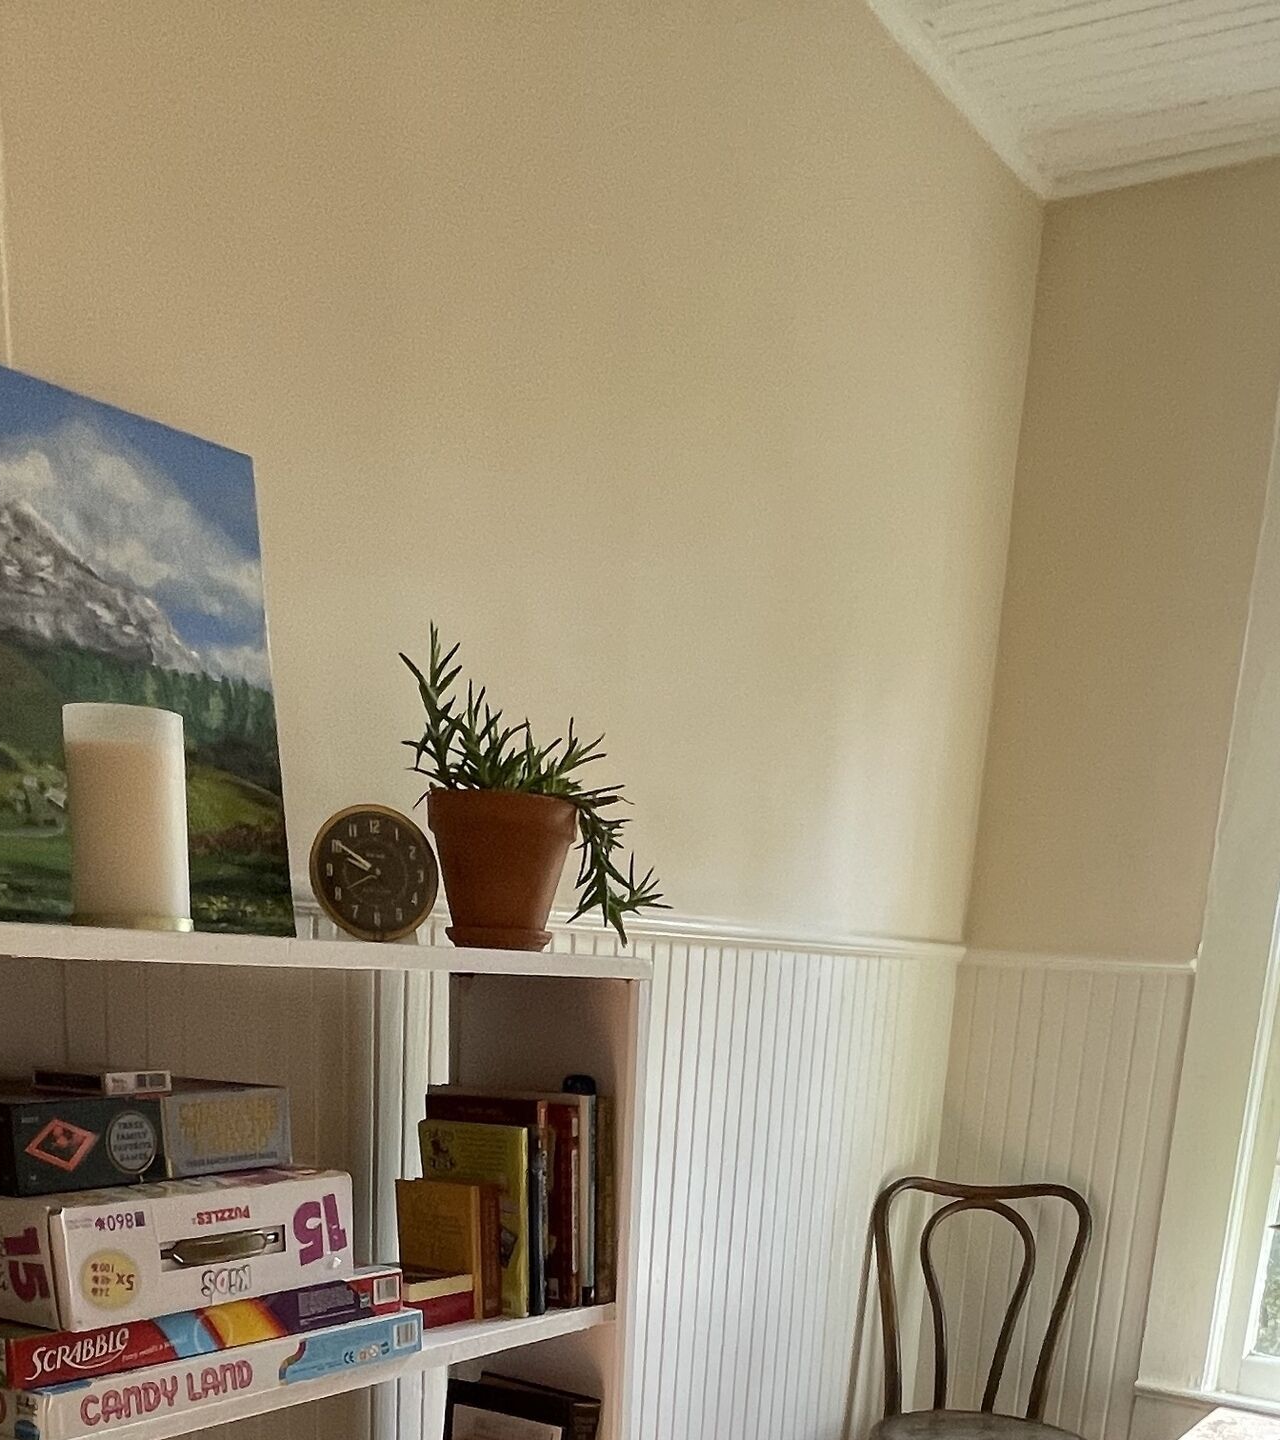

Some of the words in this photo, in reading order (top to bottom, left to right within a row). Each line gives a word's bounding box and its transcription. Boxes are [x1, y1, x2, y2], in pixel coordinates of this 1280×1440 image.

[348, 823, 358, 837] 11
[370, 820, 380, 834] 12
[409, 845, 416, 860] 2
[410, 892, 418, 906] 4
[351, 905, 359, 919] 7
[107, 1212, 135, 1232] 860
[196, 1205, 252, 1227] PUZZLES
[292, 1193, 348, 1267] 15
[3, 1226, 51, 1304] 15
[25, 1327, 130, 1382] SCRABBLE
[80, 1377, 179, 1427] CANDY
[187, 1359, 254, 1402] LAND
